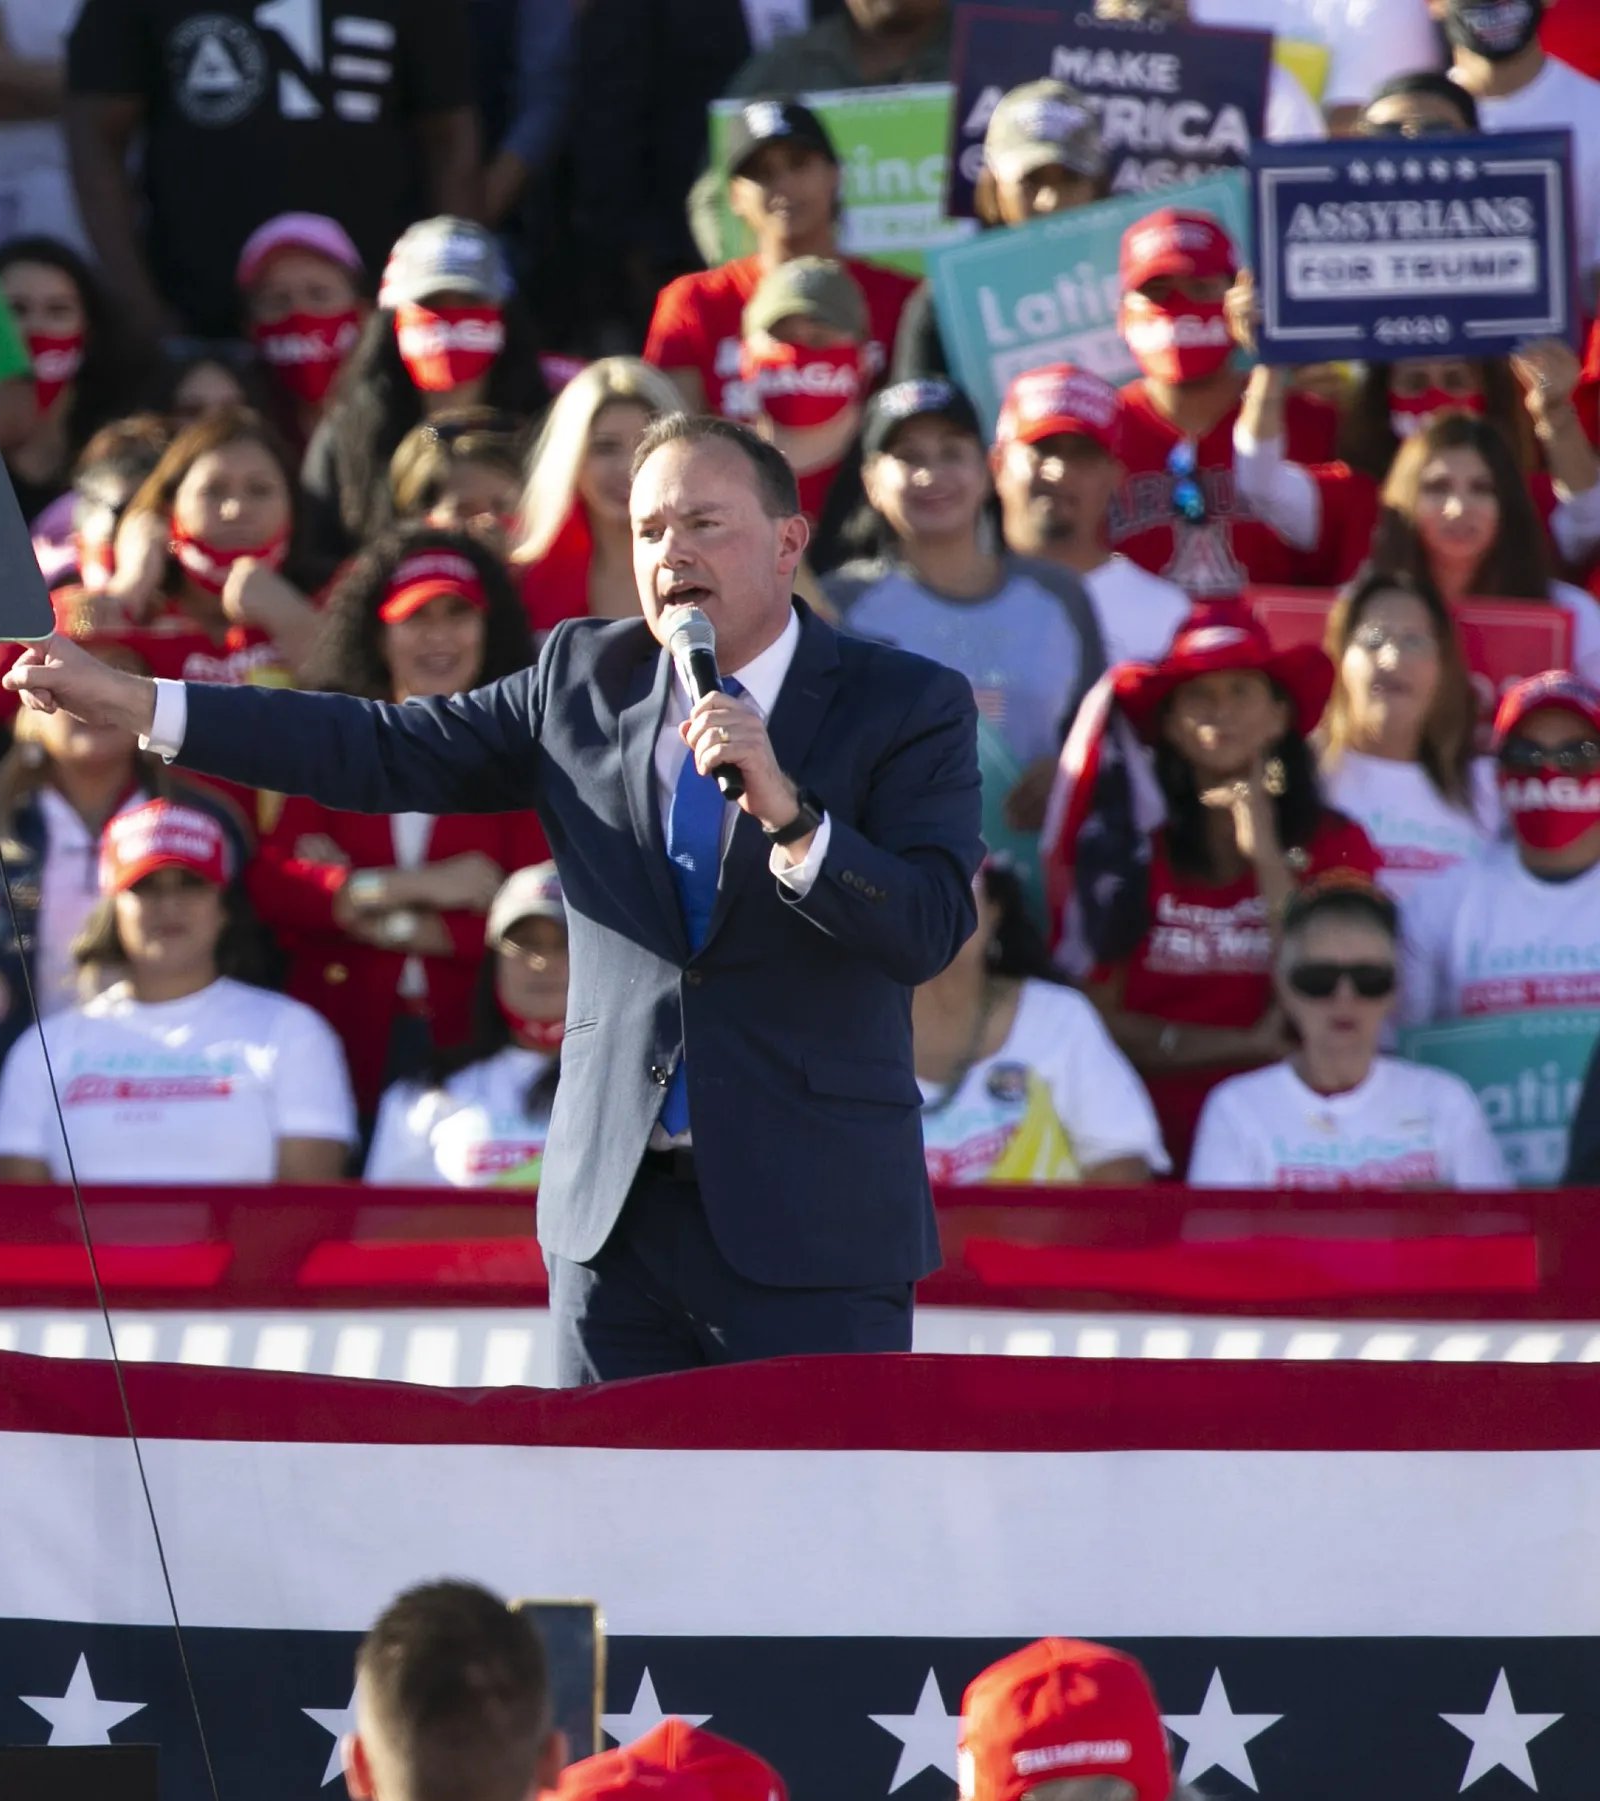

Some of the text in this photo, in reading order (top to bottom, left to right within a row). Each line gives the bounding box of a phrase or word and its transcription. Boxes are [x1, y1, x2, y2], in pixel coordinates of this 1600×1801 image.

[1052, 46, 1180, 93] MAKE
[964, 86, 1248, 158] ARICA
[1286, 196, 1536, 241] ASSYRIANS
[1302, 251, 1522, 282] FOR TRUMP
